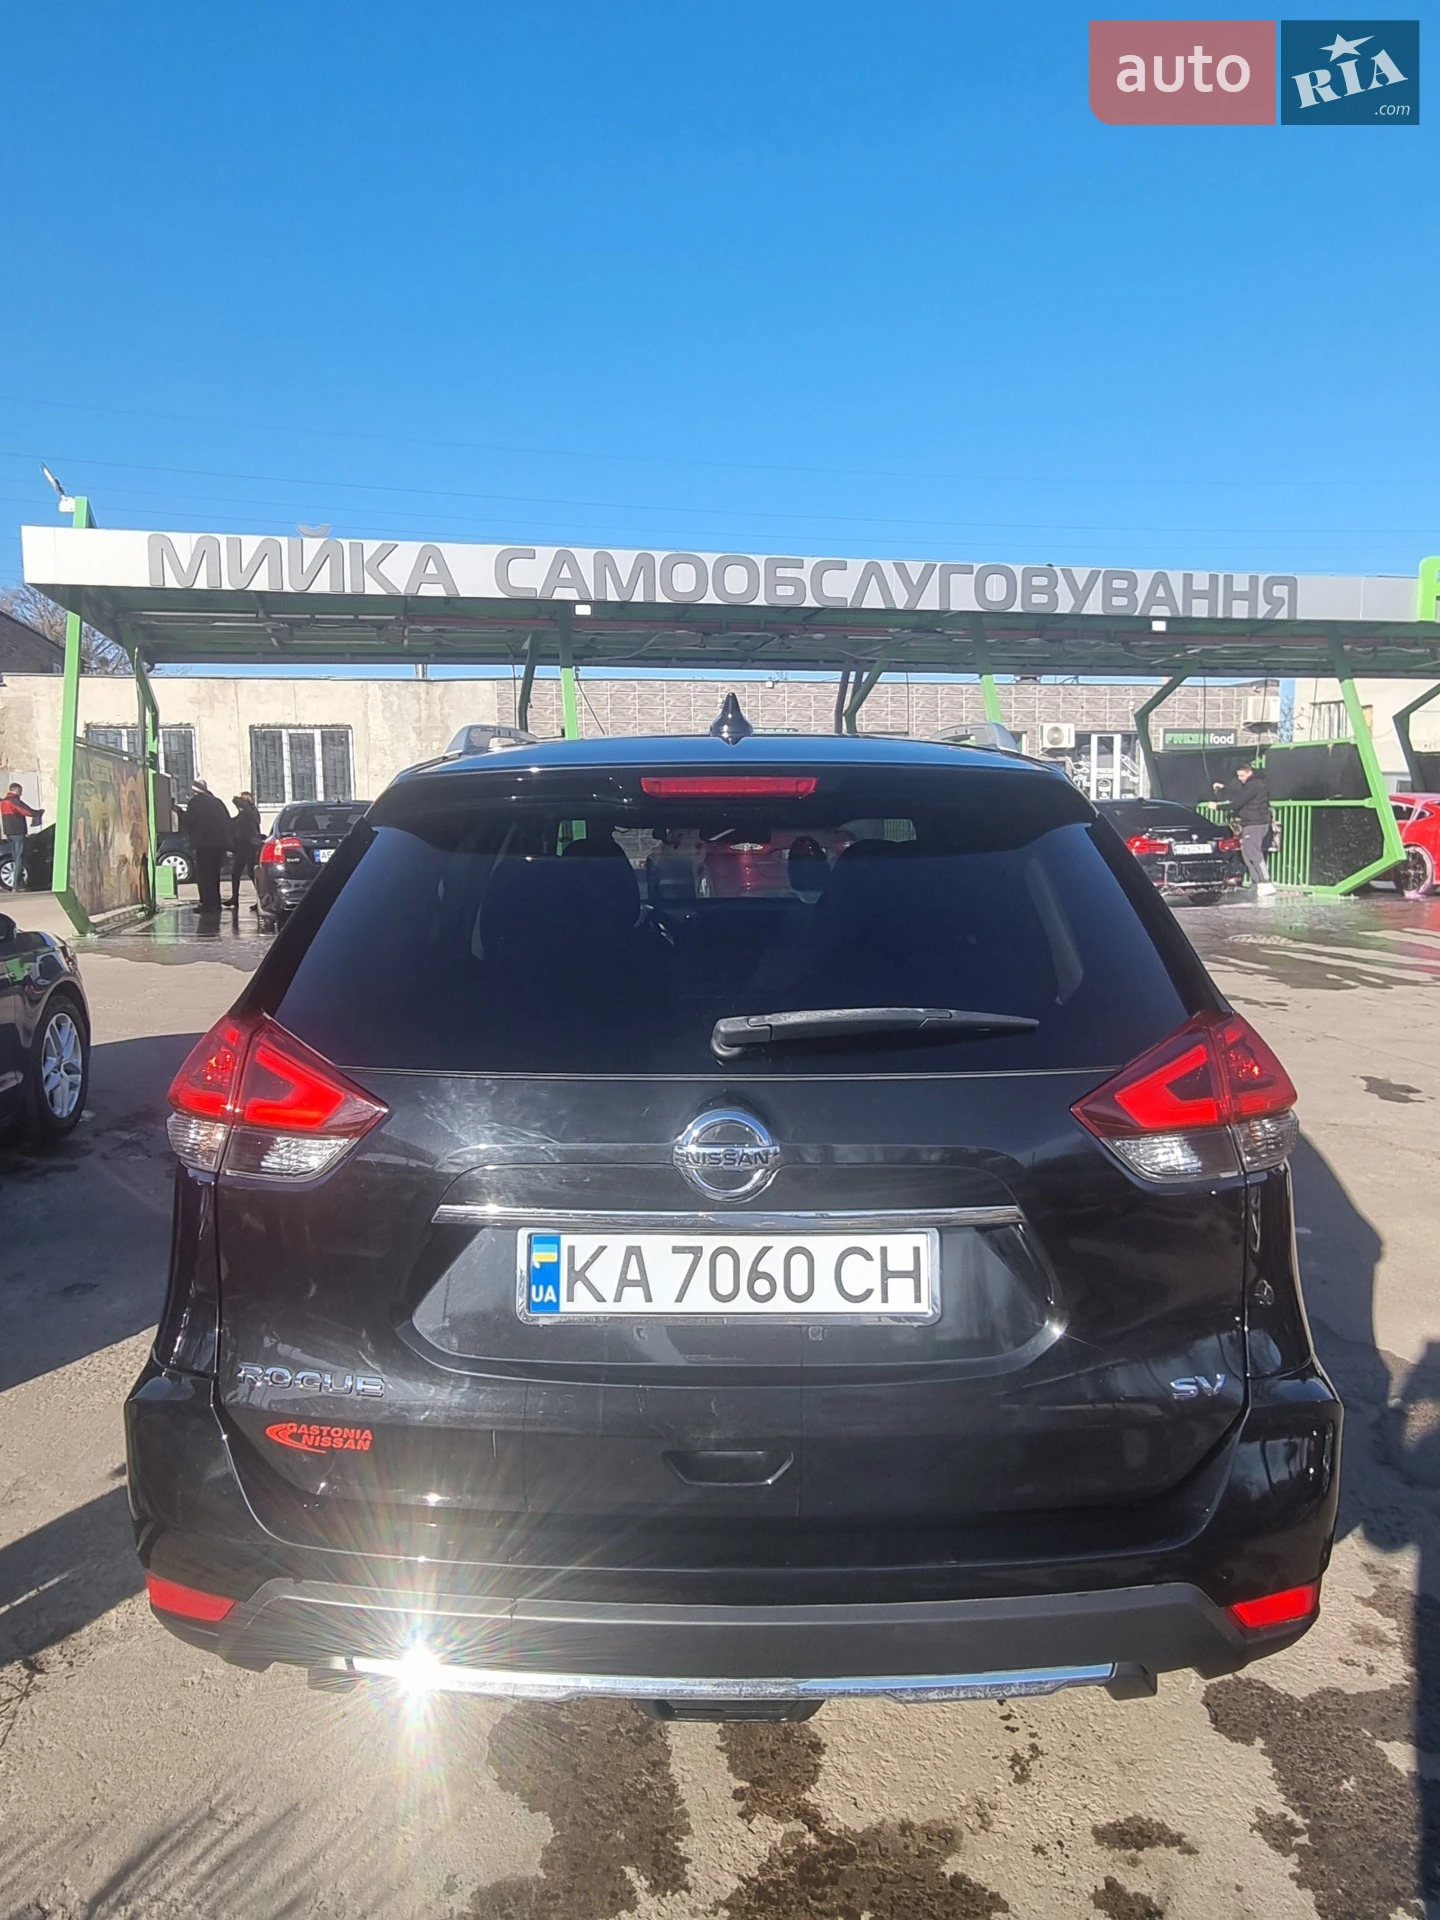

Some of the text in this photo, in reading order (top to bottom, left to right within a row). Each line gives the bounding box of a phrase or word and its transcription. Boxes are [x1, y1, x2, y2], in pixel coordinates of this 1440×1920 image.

[147, 523, 1299, 620] МИЙКА САМООБСЛУГОВУВАННЯ
[685, 1148, 771, 1166] NISSAN
[566, 1244, 923, 1305] KA 7060 CH
[531, 1284, 558, 1304] UA
[236, 1362, 385, 1398] ROGUE
[1169, 1373, 1227, 1400] SV
[288, 1422, 373, 1441] GASTONIA
[301, 1434, 371, 1451] NISSAN
